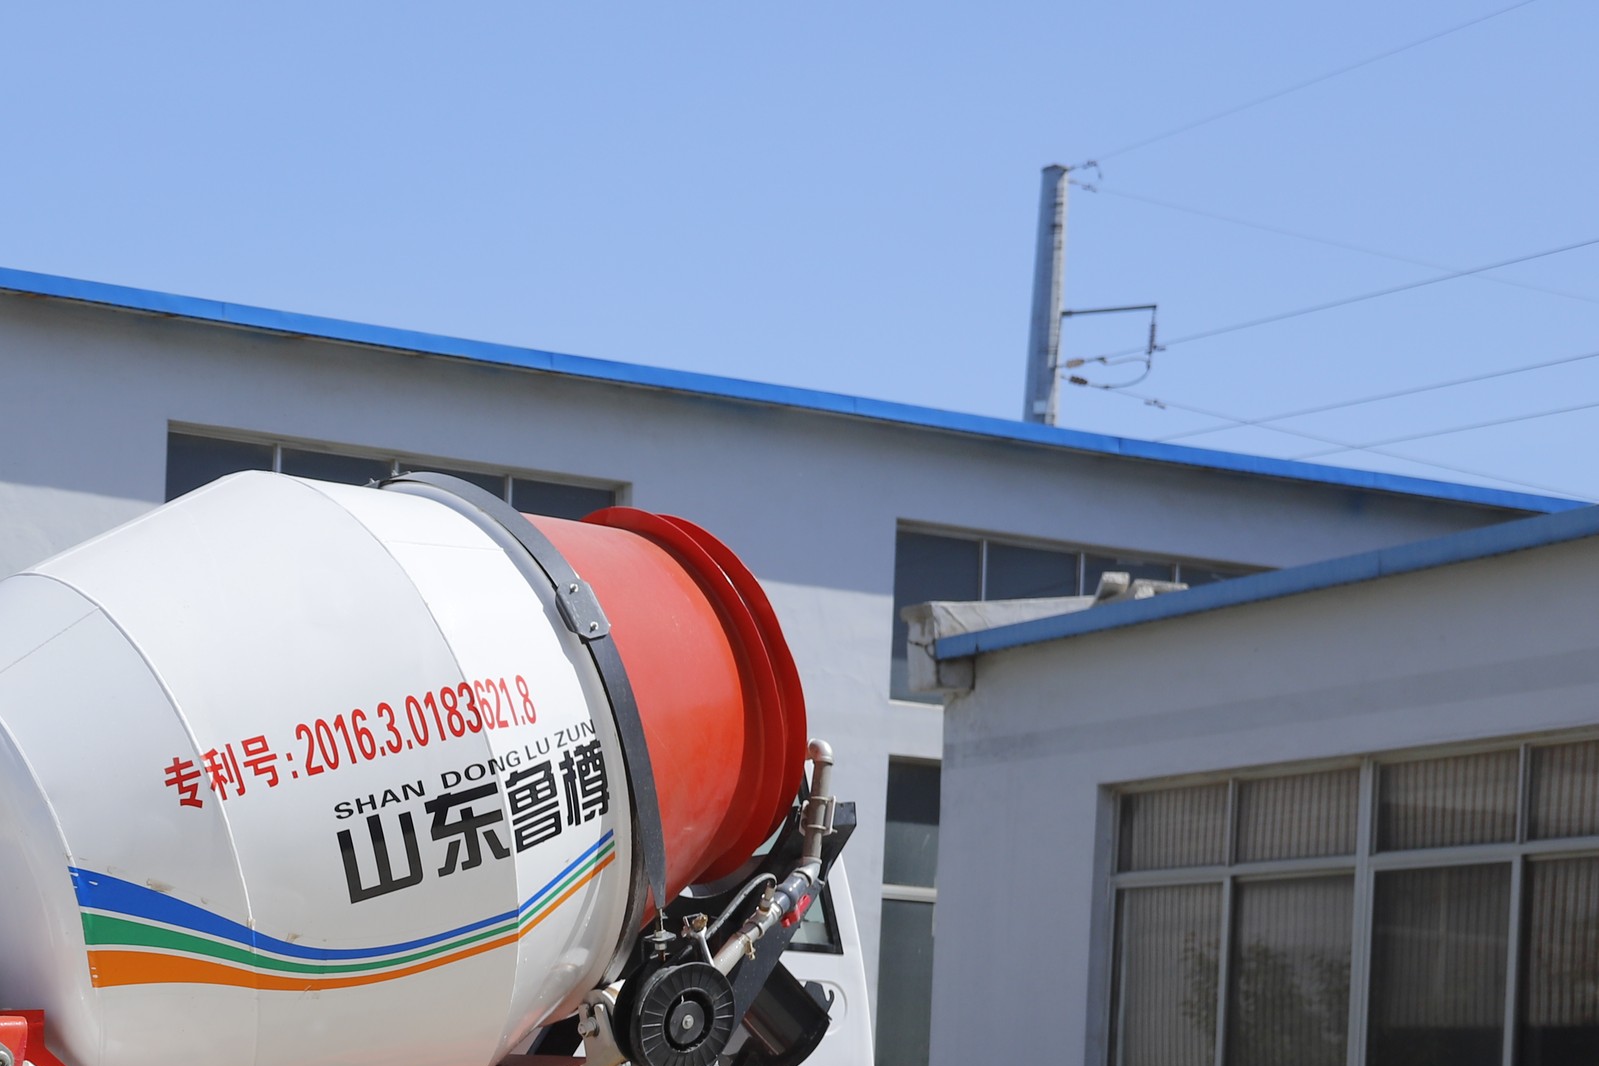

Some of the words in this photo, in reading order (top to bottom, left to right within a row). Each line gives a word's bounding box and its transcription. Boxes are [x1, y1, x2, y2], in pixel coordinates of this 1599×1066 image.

[333, 779, 426, 820] SHAN
[440, 749, 521, 790] DONG
[524, 736, 551, 761] LU
[553, 718, 597, 749] ZUN
[336, 739, 610, 904] 山东鲁樽
